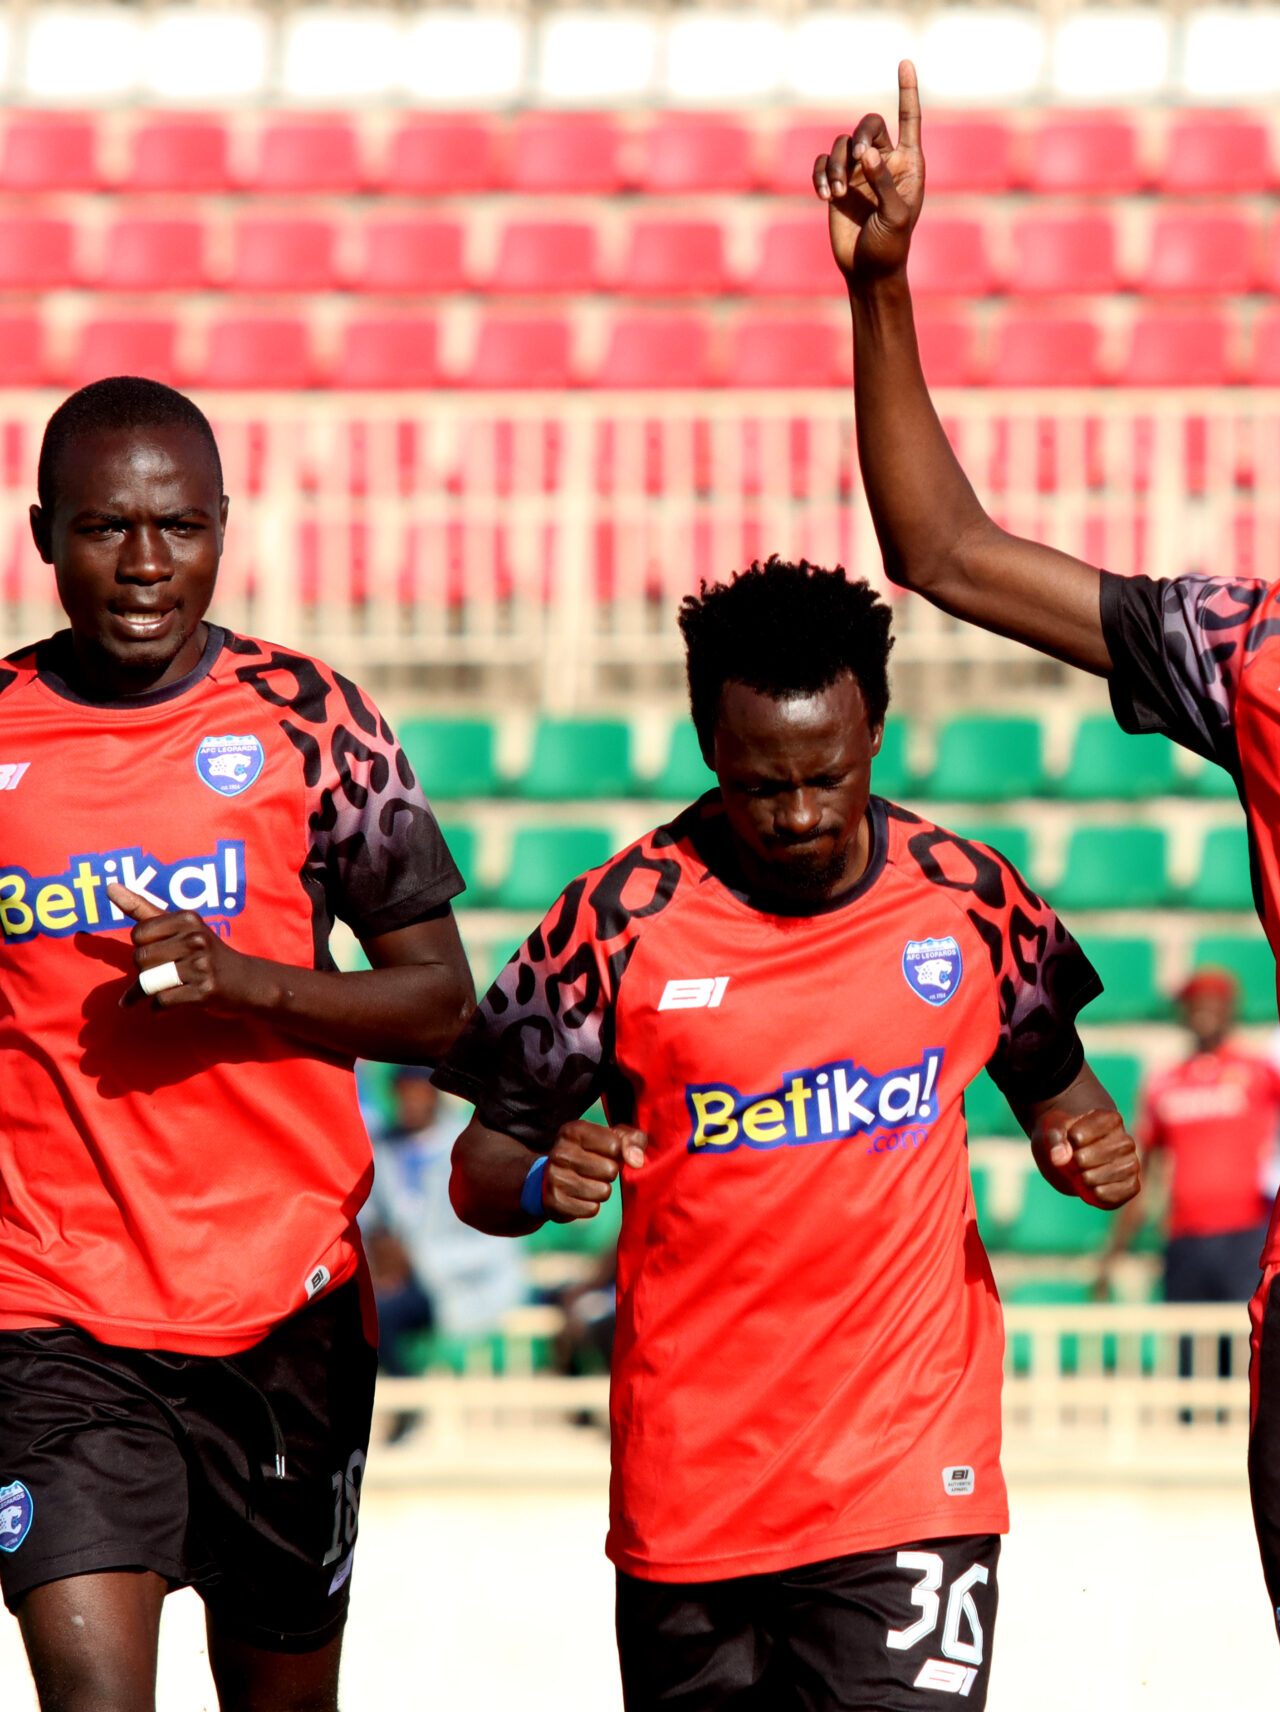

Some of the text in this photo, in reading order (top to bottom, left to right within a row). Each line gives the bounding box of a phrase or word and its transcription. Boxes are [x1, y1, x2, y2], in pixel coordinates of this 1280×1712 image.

[0, 848, 237, 936] Betika!
[906, 949, 957, 960] AFC LEOPARDS
[690, 1056, 939, 1147] Betika!
[866, 1128, 929, 1154] .com
[886, 1551, 989, 1666] 36
